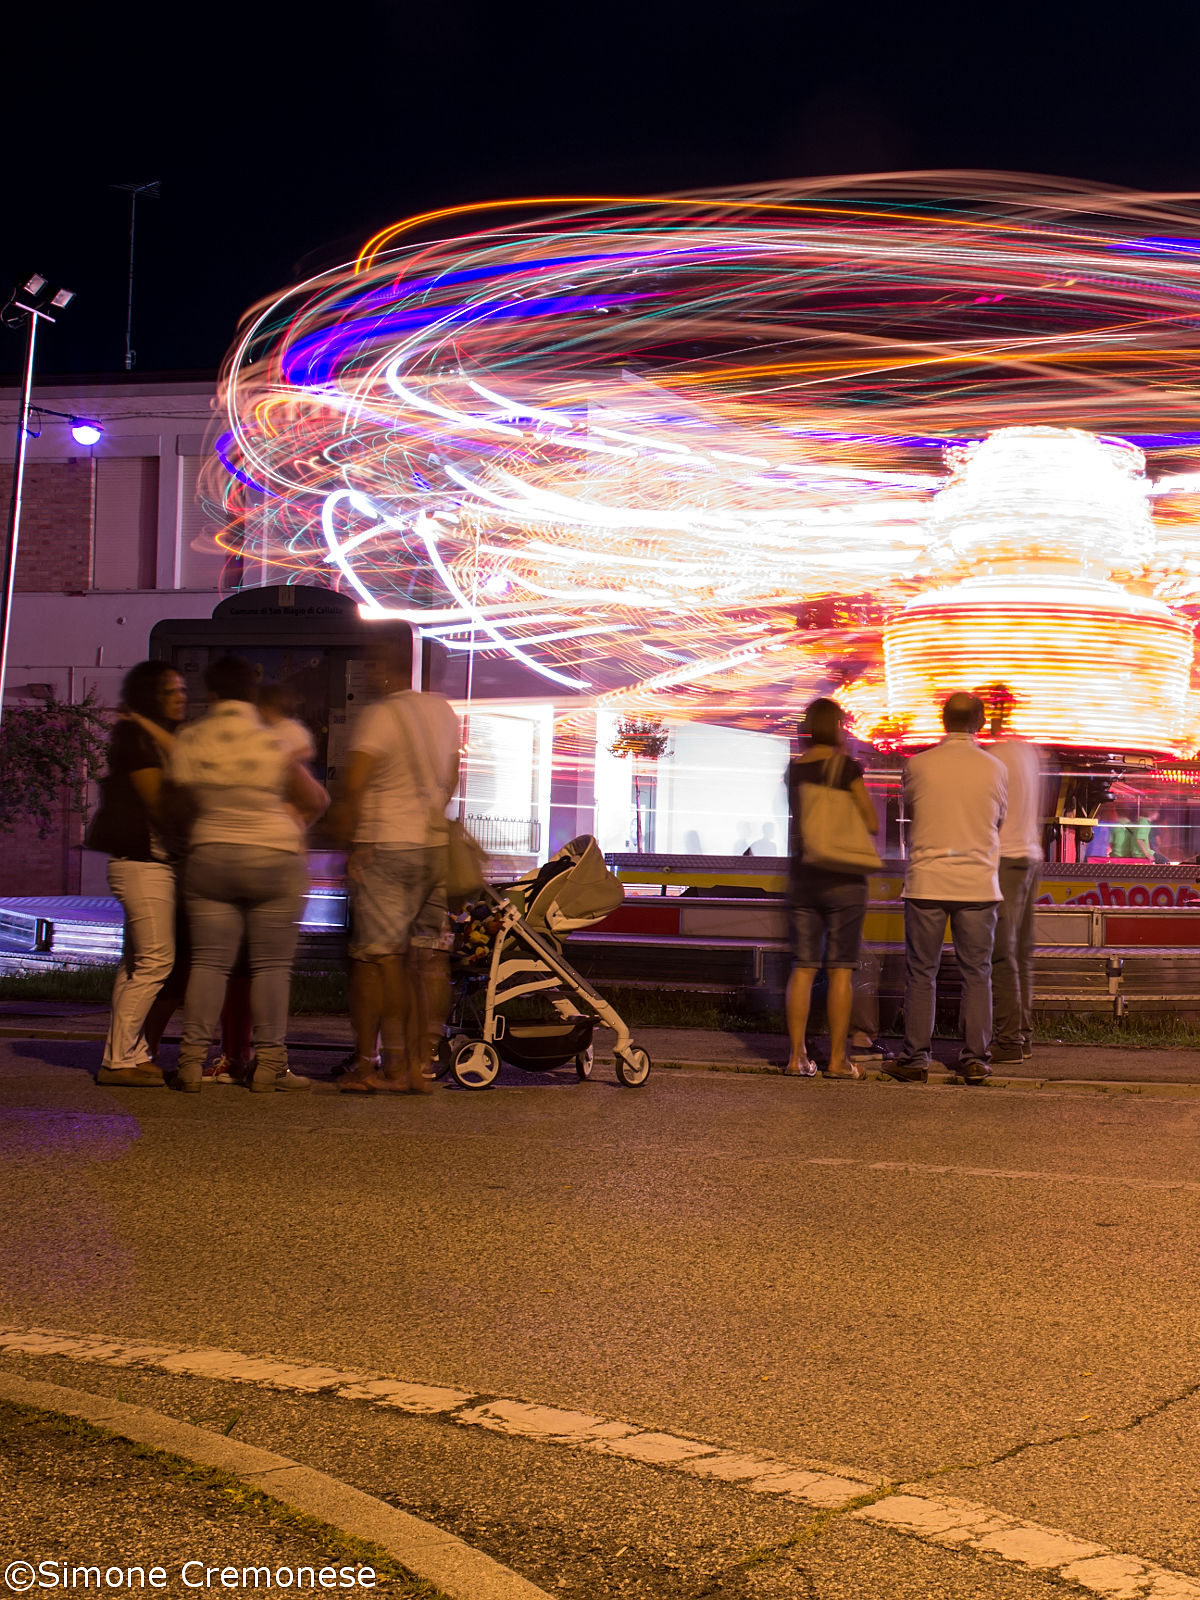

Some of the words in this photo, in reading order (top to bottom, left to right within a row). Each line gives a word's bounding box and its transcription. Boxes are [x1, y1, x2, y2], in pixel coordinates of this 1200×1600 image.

[230, 607, 259, 616] Comune
[260, 607, 267, 615] di
[269, 607, 282, 615] San
[283, 607, 306, 617] Biagio
[307, 606, 315, 615] di
